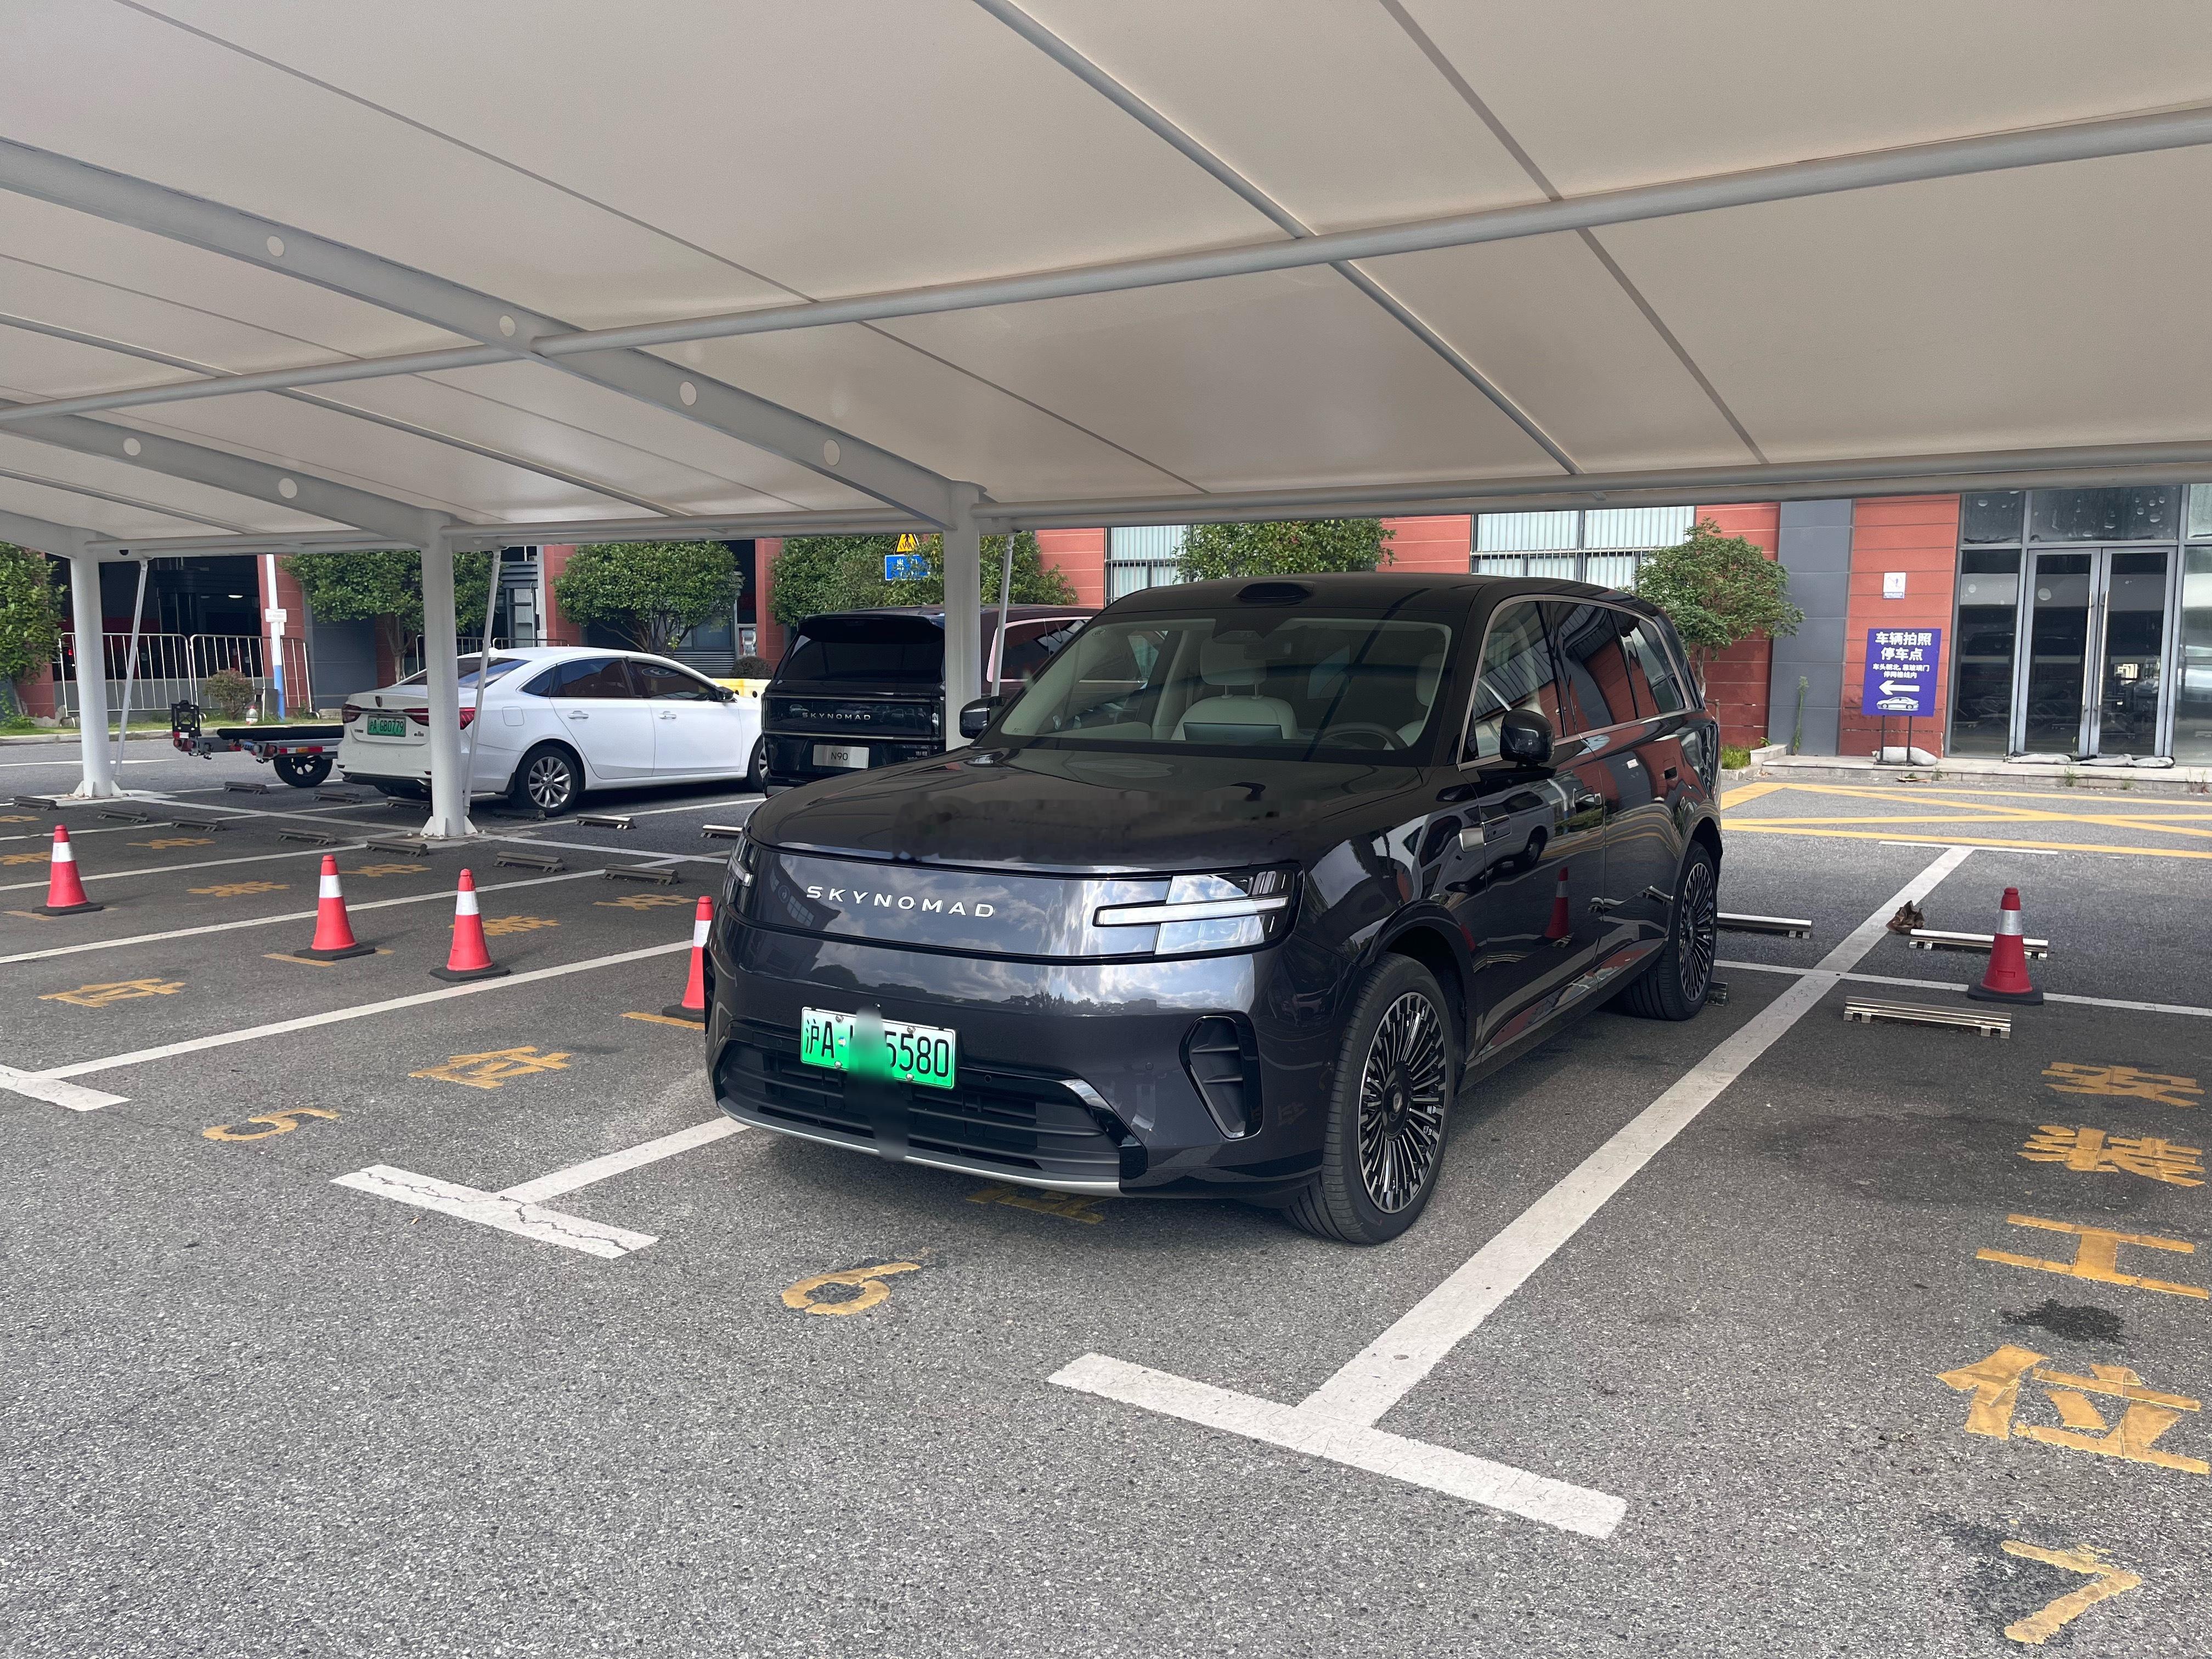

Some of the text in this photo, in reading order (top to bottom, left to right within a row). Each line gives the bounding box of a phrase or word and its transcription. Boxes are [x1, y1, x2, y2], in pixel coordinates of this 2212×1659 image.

[1875, 631, 1932, 646] 车辆拍照
[1881, 647, 1923, 661] 停车点
[802, 712, 871, 720] SKYNOMAD
[831, 752, 848, 761] N90
[806, 885, 995, 918] SKYNOMAD
[201, 1107, 341, 1142] 5
[781, 1261, 922, 1315] 6
